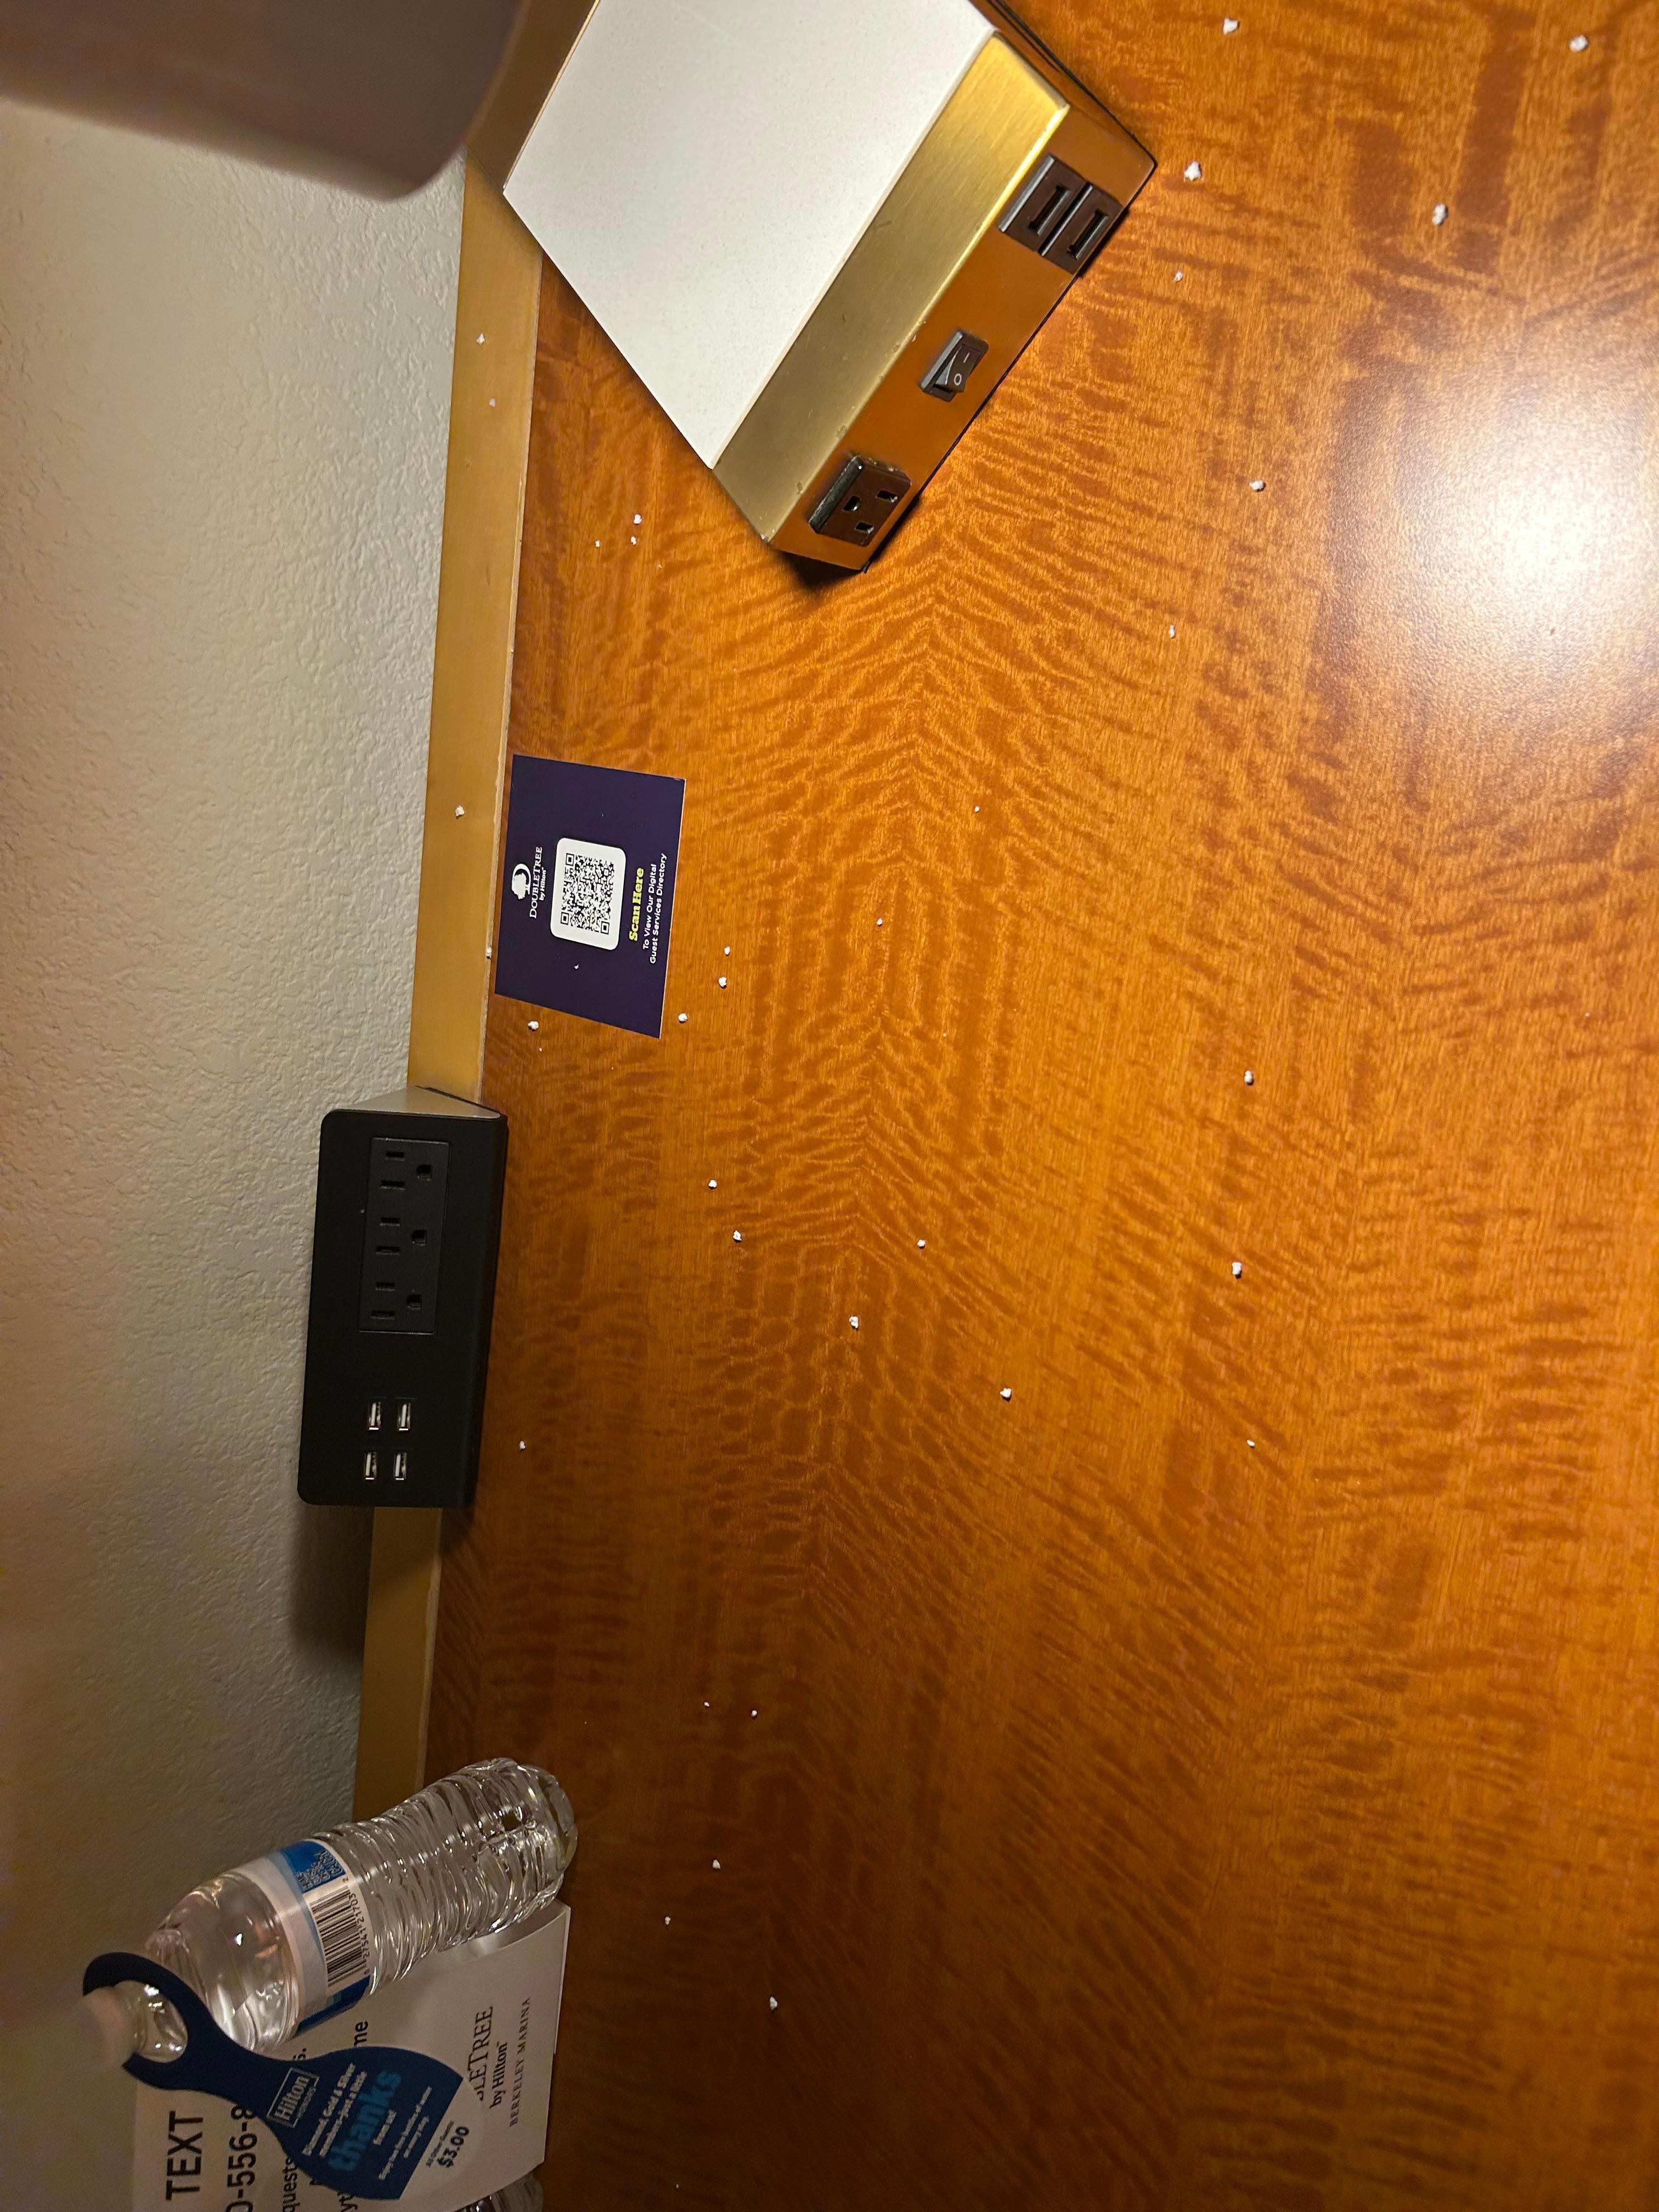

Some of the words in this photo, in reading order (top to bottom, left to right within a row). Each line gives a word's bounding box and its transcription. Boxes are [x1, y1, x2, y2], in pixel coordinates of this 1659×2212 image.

[529, 847, 543, 919] DOUBLETREE
[633, 868, 645, 905] Here
[657, 853, 667, 896] Directory
[539, 892, 546, 900] by
[643, 939, 650, 950] To
[648, 864, 657, 894] Digital
[652, 898, 662, 936] Services
[629, 906, 641, 941] Scan
[650, 938, 658, 964] Guest
[348, 1893, 365, 1925] 21703
[358, 1928, 370, 1960] 27541
[467, 2006, 493, 2101] LETREE
[509, 2058, 524, 2128] BERKELEY
[517, 1997, 531, 2054] MARINA
[274, 2076, 309, 2120] Hilton
[489, 2090, 506, 2109] by
[328, 2070, 401, 2172] thanks
[166, 2111, 204, 2201] TEXT
[437, 2126, 470, 2168] $3.00
